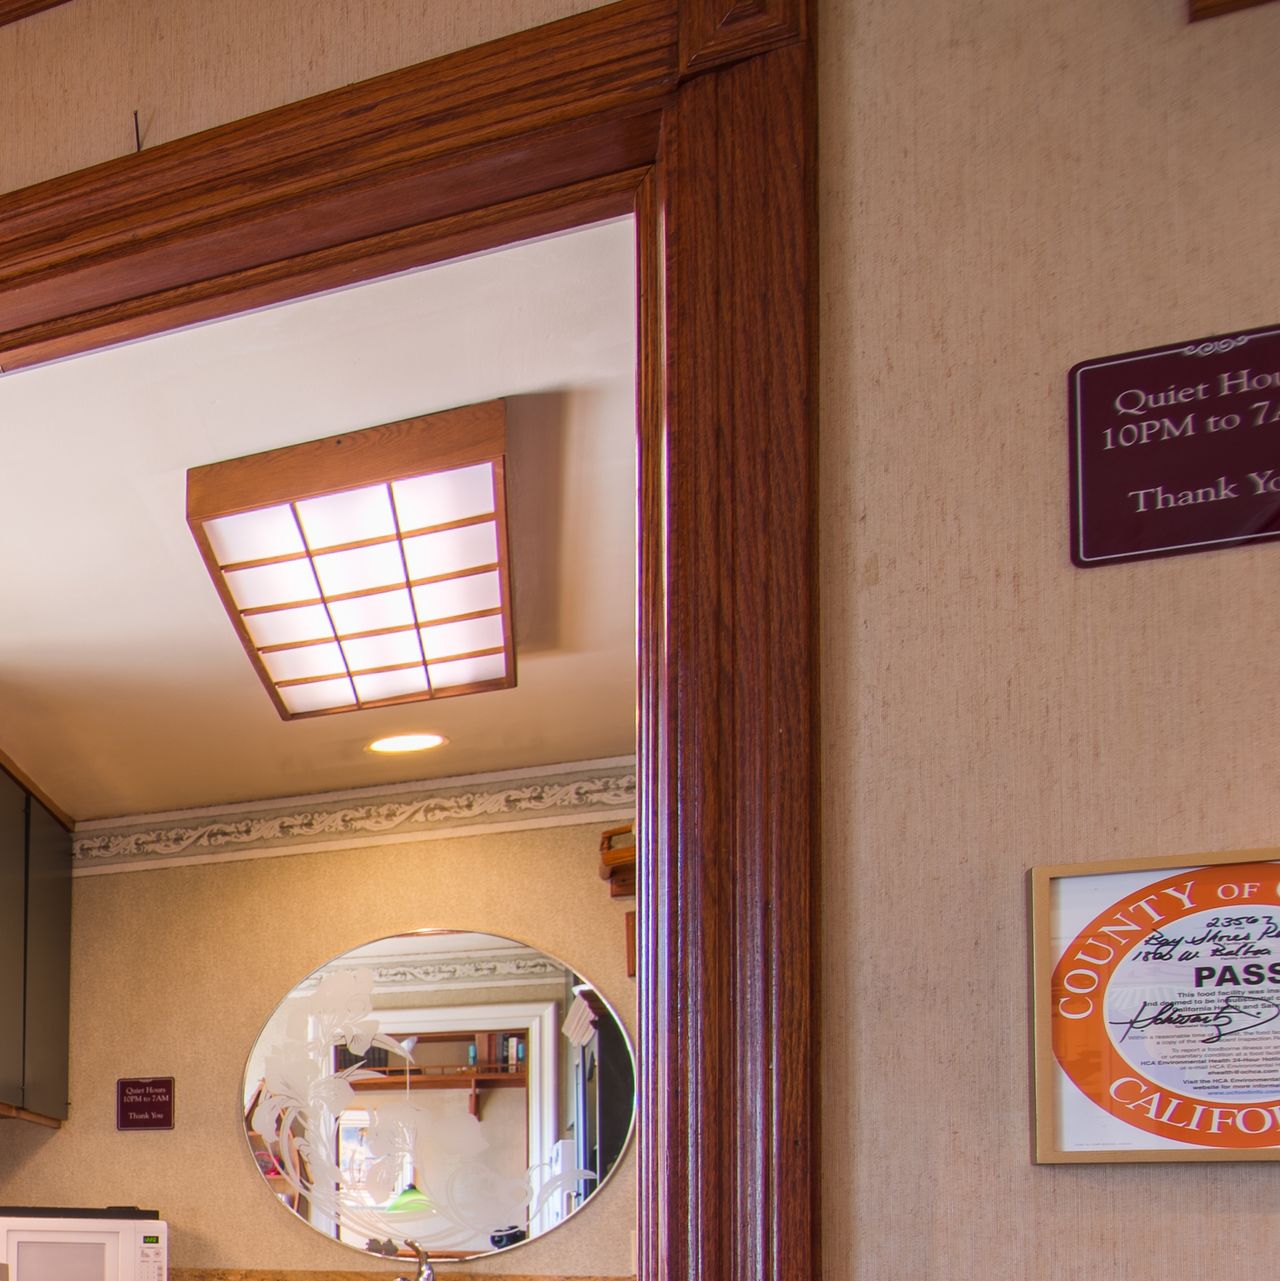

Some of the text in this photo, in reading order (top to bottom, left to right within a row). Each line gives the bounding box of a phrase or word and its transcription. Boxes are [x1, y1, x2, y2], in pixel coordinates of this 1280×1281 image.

[1114, 383, 1209, 416] Quiet
[1103, 413, 1196, 450] 10PM
[1206, 413, 1241, 433] to
[1128, 476, 1239, 513] Thank
[1058, 880, 1261, 1020] COUNTY OF
[123, 1094, 142, 1103] 10PM
[152, 1094, 169, 1102] 7AM
[125, 1085, 166, 1095] Quiet Hours
[127, 1111, 164, 1120] Thank You
